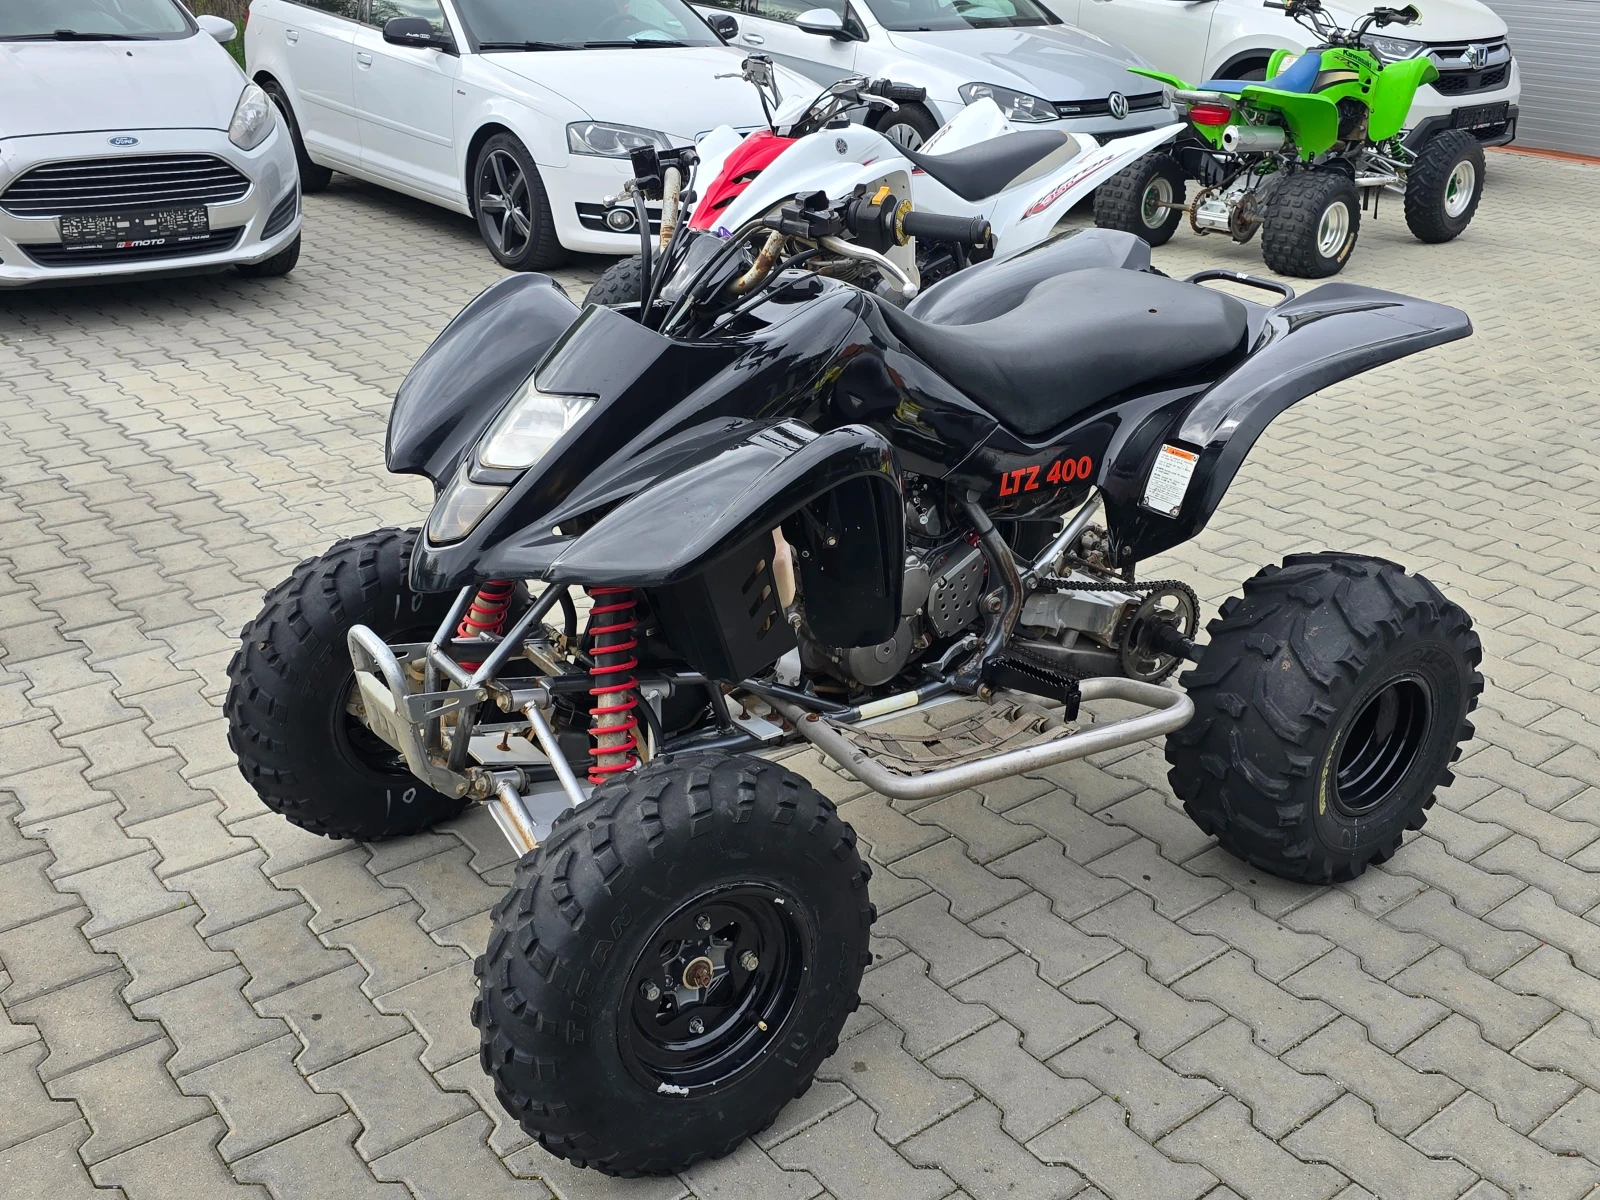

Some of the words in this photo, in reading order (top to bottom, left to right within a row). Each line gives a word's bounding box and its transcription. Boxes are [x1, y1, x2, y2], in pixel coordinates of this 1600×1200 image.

[1342, 49, 1372, 69] Kawasaki
[999, 465, 1040, 497] LTZ
[1046, 455, 1092, 485] 400
[566, 902, 633, 1045] TITAN
